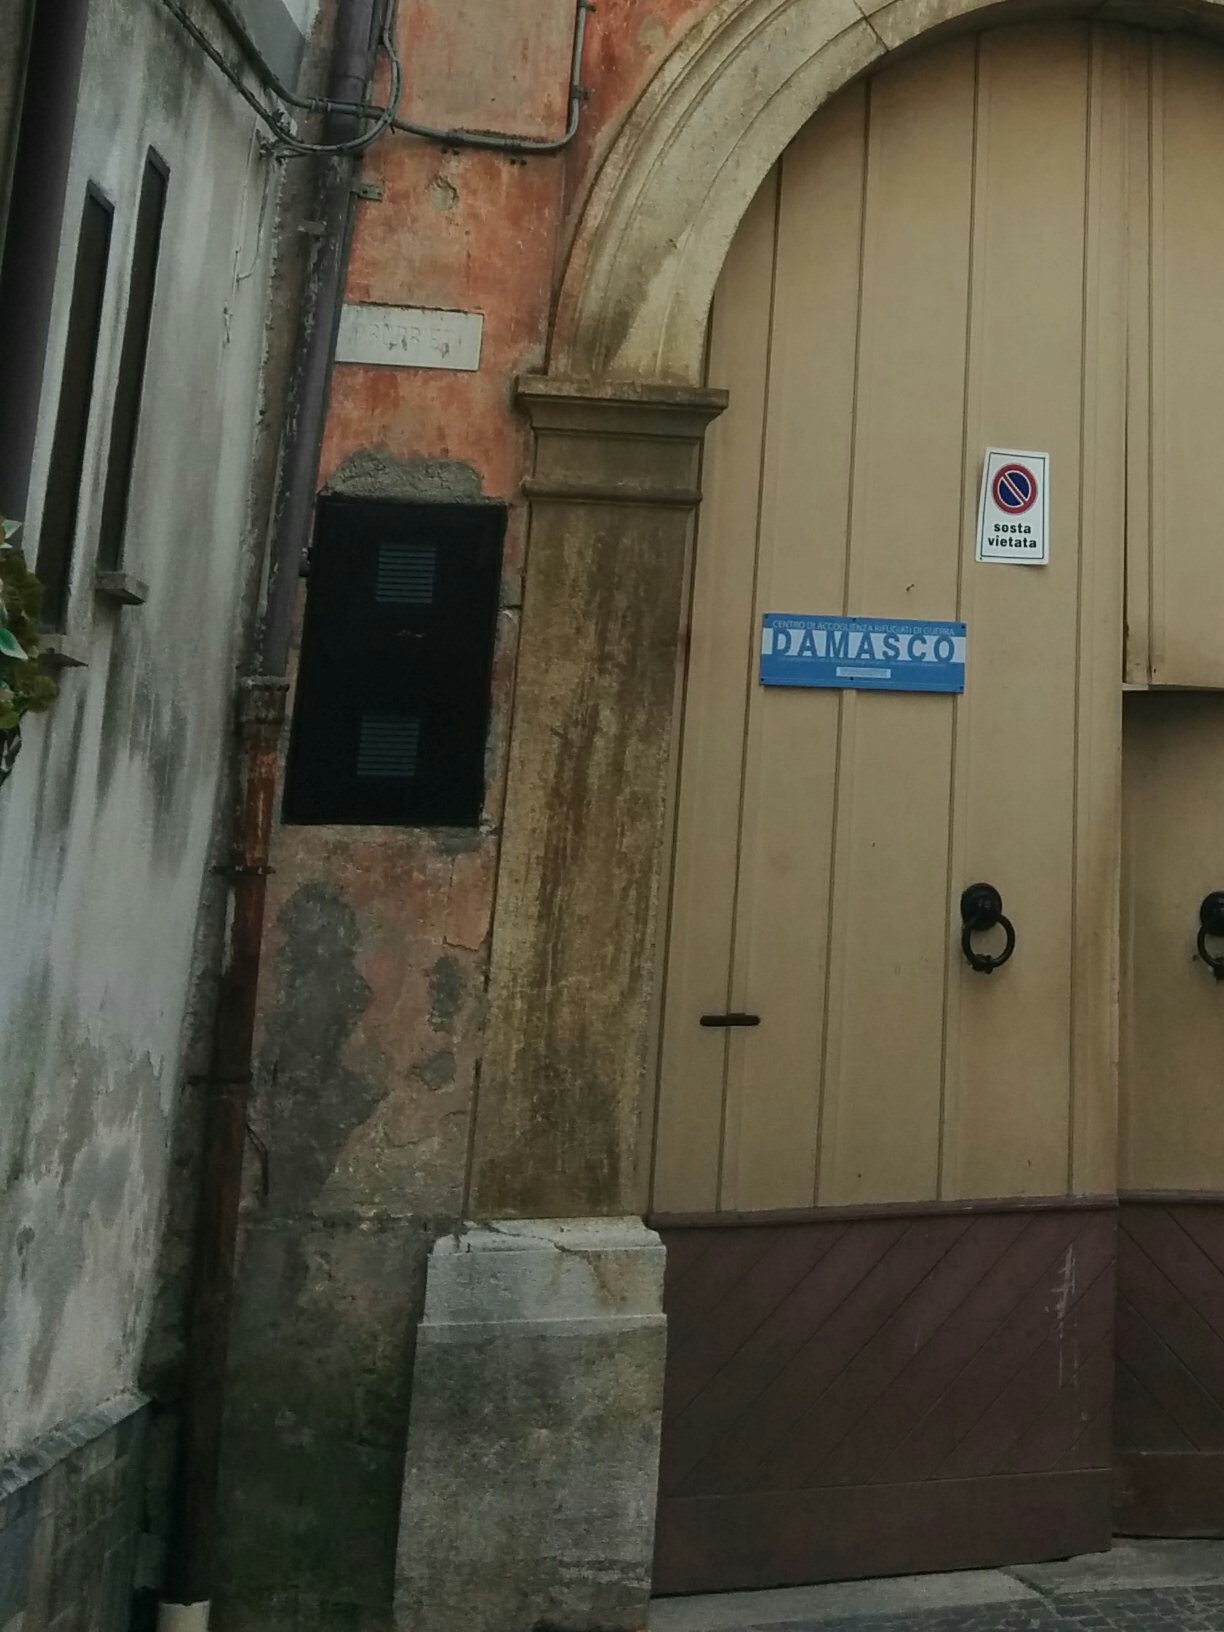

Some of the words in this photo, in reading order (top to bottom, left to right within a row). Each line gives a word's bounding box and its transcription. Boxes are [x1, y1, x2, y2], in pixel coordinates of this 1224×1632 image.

[994, 523, 1031, 534] sosta
[988, 535, 1037, 548] vietata
[772, 619, 805, 630] CENTRO
[773, 628, 955, 663] DAMASCO
